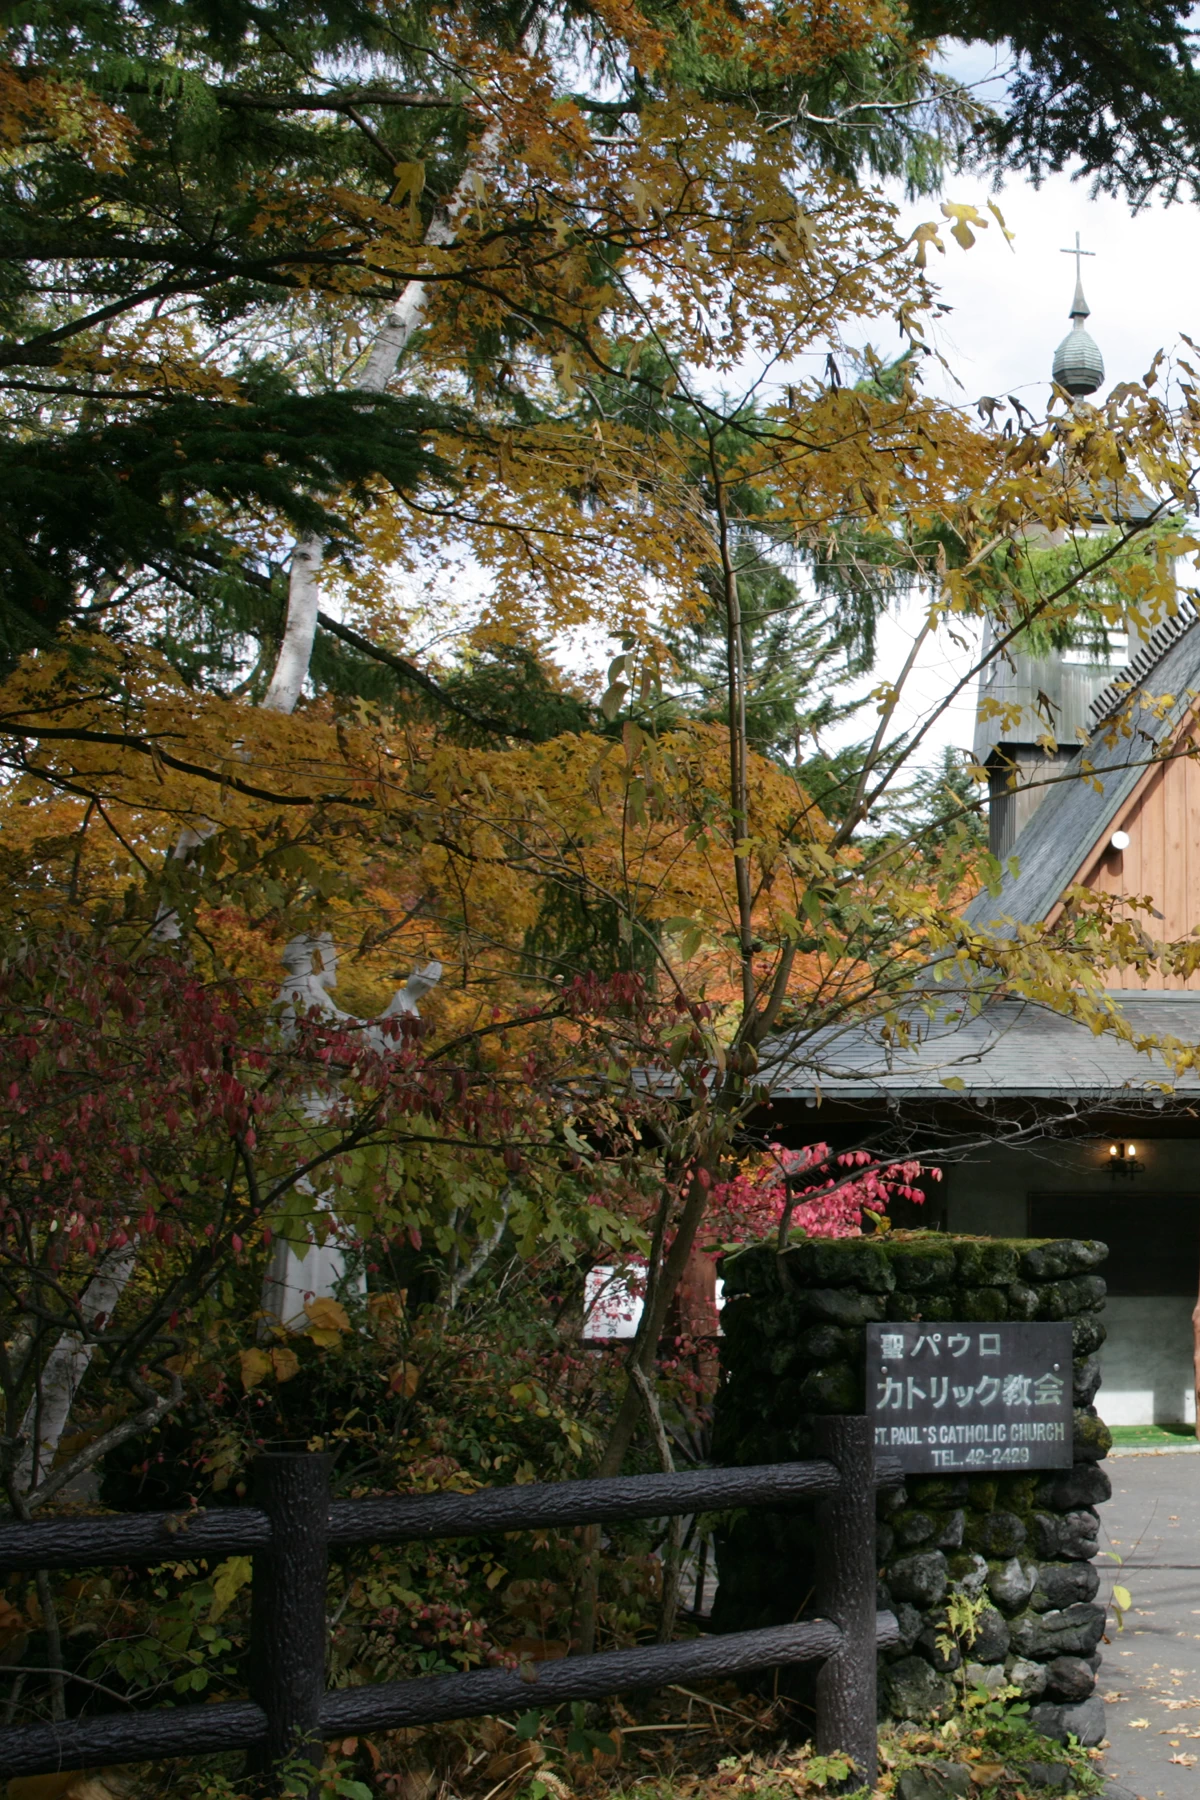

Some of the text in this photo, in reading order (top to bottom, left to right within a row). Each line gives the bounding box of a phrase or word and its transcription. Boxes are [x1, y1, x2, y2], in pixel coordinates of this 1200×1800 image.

[880, 1333, 1001, 1359] 聖パウロ
[876, 1372, 1065, 1409] カトリック教会
[939, 1423, 1007, 1443] CATHOLIC
[1010, 1422, 1065, 1441] CHURCH
[965, 1447, 1030, 1465] 42-2429
